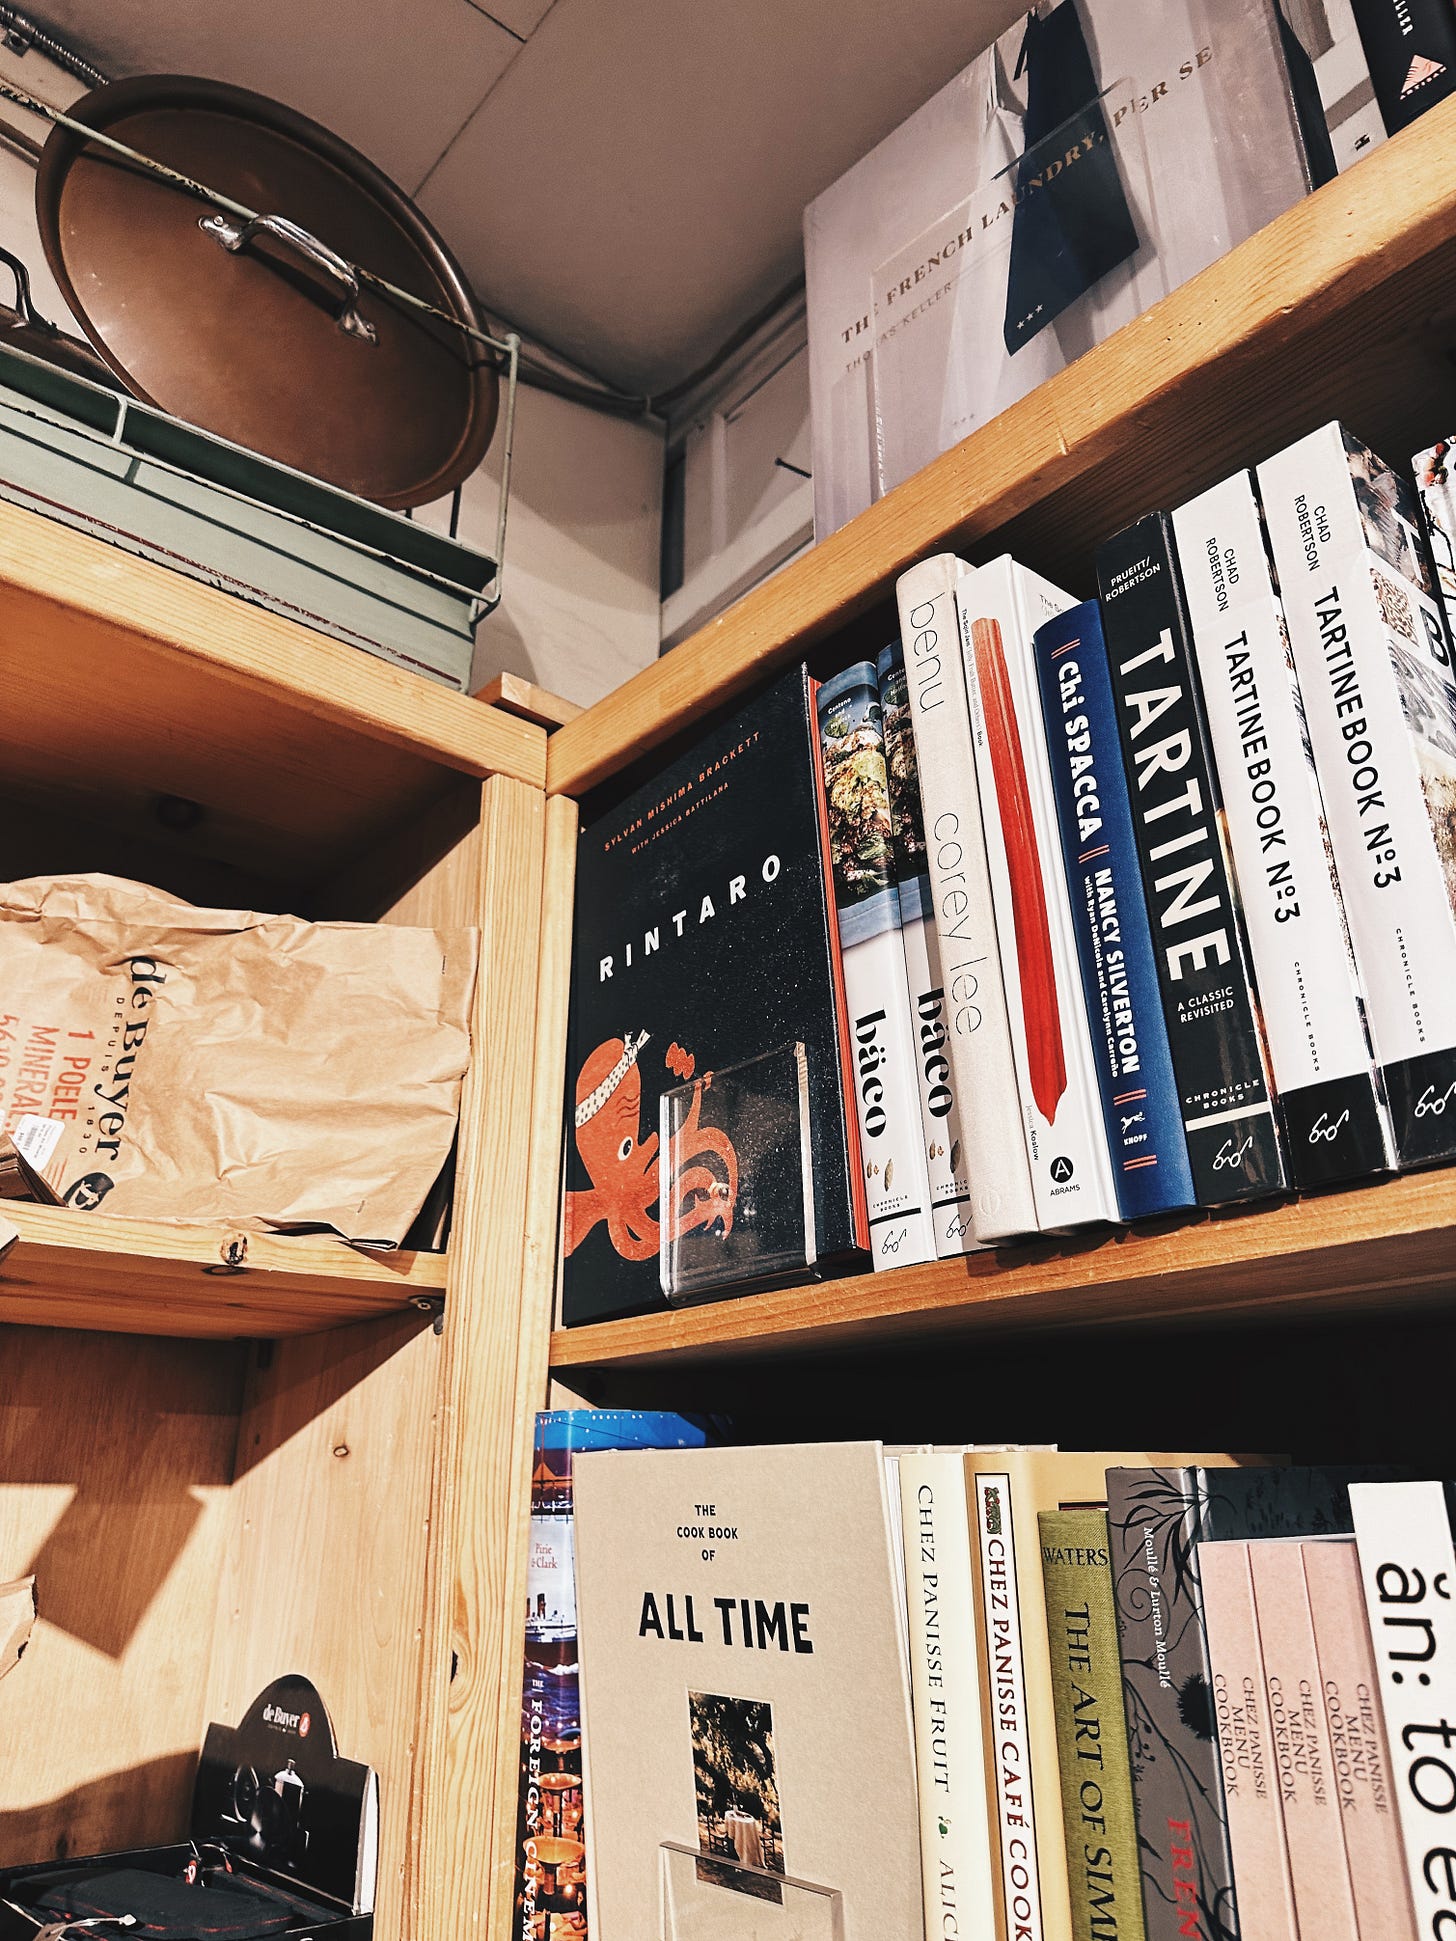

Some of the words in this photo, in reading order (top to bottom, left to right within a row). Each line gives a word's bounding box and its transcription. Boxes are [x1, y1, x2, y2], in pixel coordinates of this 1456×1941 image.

[1392, 0, 1414, 36] LLER
[886, 226, 973, 305] FRENCH
[1112, 81, 1169, 128] PER
[1178, 46, 1213, 81] SE
[902, 282, 953, 326] KELLER
[1293, 494, 1320, 571] ROBERTSON
[1313, 505, 1332, 544] CHAD
[1105, 562, 1161, 602] ROBERTSON
[1110, 556, 1150, 586] PRUEITT/
[1206, 537, 1229, 612] ROBERTSON
[1223, 548, 1240, 585] CHAD
[909, 591, 946, 714] benu
[1058, 660, 1085, 714] Chi
[604, 818, 643, 851] SYLVAN
[647, 782, 693, 820] MISHIMA
[698, 731, 760, 783] BRACKETT
[1065, 714, 1103, 843] SPACCA
[1119, 627, 1232, 981] TARTINE
[631, 839, 649, 855] WITH
[651, 815, 683, 840] JESSICA
[685, 782, 729, 817] BATTILANA
[934, 811, 972, 940] corey
[1084, 875, 1094, 898] with
[1094, 867, 1121, 943] NANCY
[599, 854, 781, 982] RINTARO
[1086, 898, 1097, 924] Ryan
[950, 956, 988, 1036] lee
[1097, 969, 1108, 989] and
[1100, 990, 1112, 1036] Carolynn
[1106, 949, 1140, 1075] SILVERTON
[1177, 1000, 1185, 1012] A
[1187, 986, 1234, 1009] CLASSIC
[1180, 999, 1234, 1023] REVISITED
[1395, 927, 1415, 996] CHRONICLE
[1412, 1002, 1426, 1043] BOOKS
[68, 1030, 95, 1040] 1
[101, 997, 125, 1072] DEPUIS
[1294, 961, 1312, 1028] CHRONICLE
[1308, 1033, 1320, 1072] BOOKS
[49, 1056, 92, 1121] POELE
[855, 1009, 887, 1138] bäco
[1185, 1079, 1260, 1104] CHRONICLE
[1203, 1093, 1244, 1109] BOOKS
[79, 1106, 95, 1154] 1830
[1030, 1129, 1039, 1161] Koslow
[1123, 1133, 1148, 1146] KNOPF
[936, 1180, 968, 1191] CHRONIC
[1050, 1184, 1081, 1197] ABRAMS
[676, 1526, 704, 1539] COOK
[708, 1527, 739, 1540] BOOK
[694, 1504, 716, 1517] THE
[917, 1484, 936, 1564] CHEZ
[701, 1549, 716, 1561] OF
[985, 1537, 1009, 1610] CHEZ
[1042, 1546, 1109, 1566] WATERS
[1143, 1526, 1159, 1573] Moullé
[1149, 1574, 1159, 1588] &
[638, 1592, 703, 1643] ALL
[713, 1596, 813, 1654] TIME
[921, 1572, 943, 1690] PANISSE
[1063, 1602, 1092, 1674] THE
[1150, 1591, 1163, 1640] Lurton
[1376, 1562, 1451, 1686] ăn:
[531, 1679, 544, 1688] THE
[992, 1617, 1018, 1732] PANISSE
[1155, 1641, 1172, 1688] Moullé
[1070, 1683, 1104, 1771] ART
[1243, 1677, 1258, 1725] CHEZ
[1299, 1680, 1317, 1729] CHEZ
[1356, 1683, 1375, 1735] CHEZ
[526, 1699, 542, 1832] FOREIGN
[929, 1699, 951, 1793] FRUIT
[1215, 1674, 1238, 1798] COOKBOOK
[1232, 1706, 1250, 1769] MENU
[1250, 1730, 1267, 1800] PANISSE
[1269, 1677, 1297, 1804] COOKBOOK
[1288, 1710, 1309, 1776] MENU
[1307, 1735, 1327, 1806] PANISSE
[1325, 1681, 1357, 1813] COOKBOOK
[1345, 1715, 1368, 1783] MENU
[1402, 1719, 1456, 1814] to
[1001, 1741, 1030, 1829] CAFÉ
[1079, 1780, 1106, 1835] OF
[1365, 1740, 1388, 1815] PANISSE
[522, 1841, 537, 1941] CINEM
[1009, 1838, 1033, 1941] COOK
[1084, 1843, 1118, 1941] SIM
[1168, 1816, 1203, 1941] FREN
[1423, 1847, 1456, 1941] e
